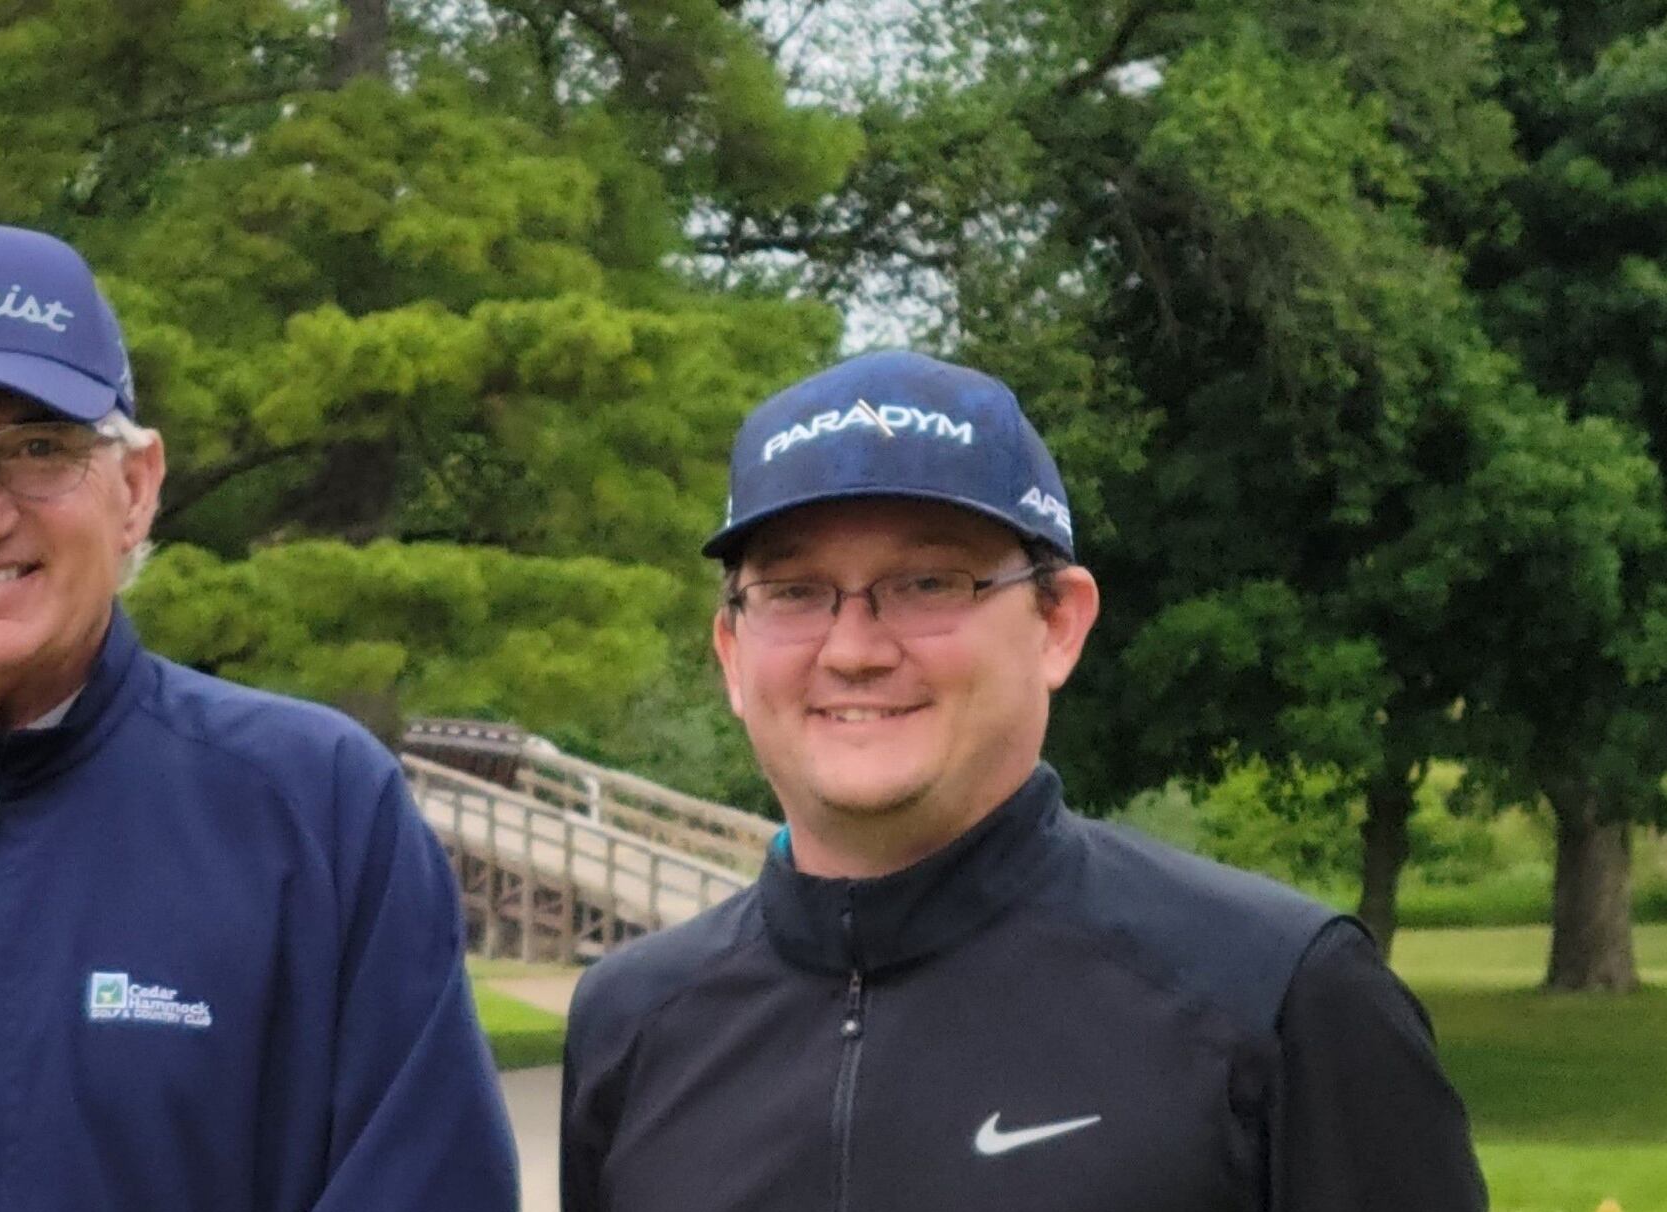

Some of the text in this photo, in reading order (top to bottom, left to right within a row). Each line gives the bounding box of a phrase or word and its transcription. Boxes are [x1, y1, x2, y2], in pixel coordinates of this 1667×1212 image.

[763, 399, 973, 461] PARADYM
[129, 984, 178, 1000] Cedar
[129, 998, 211, 1015] Hammock
